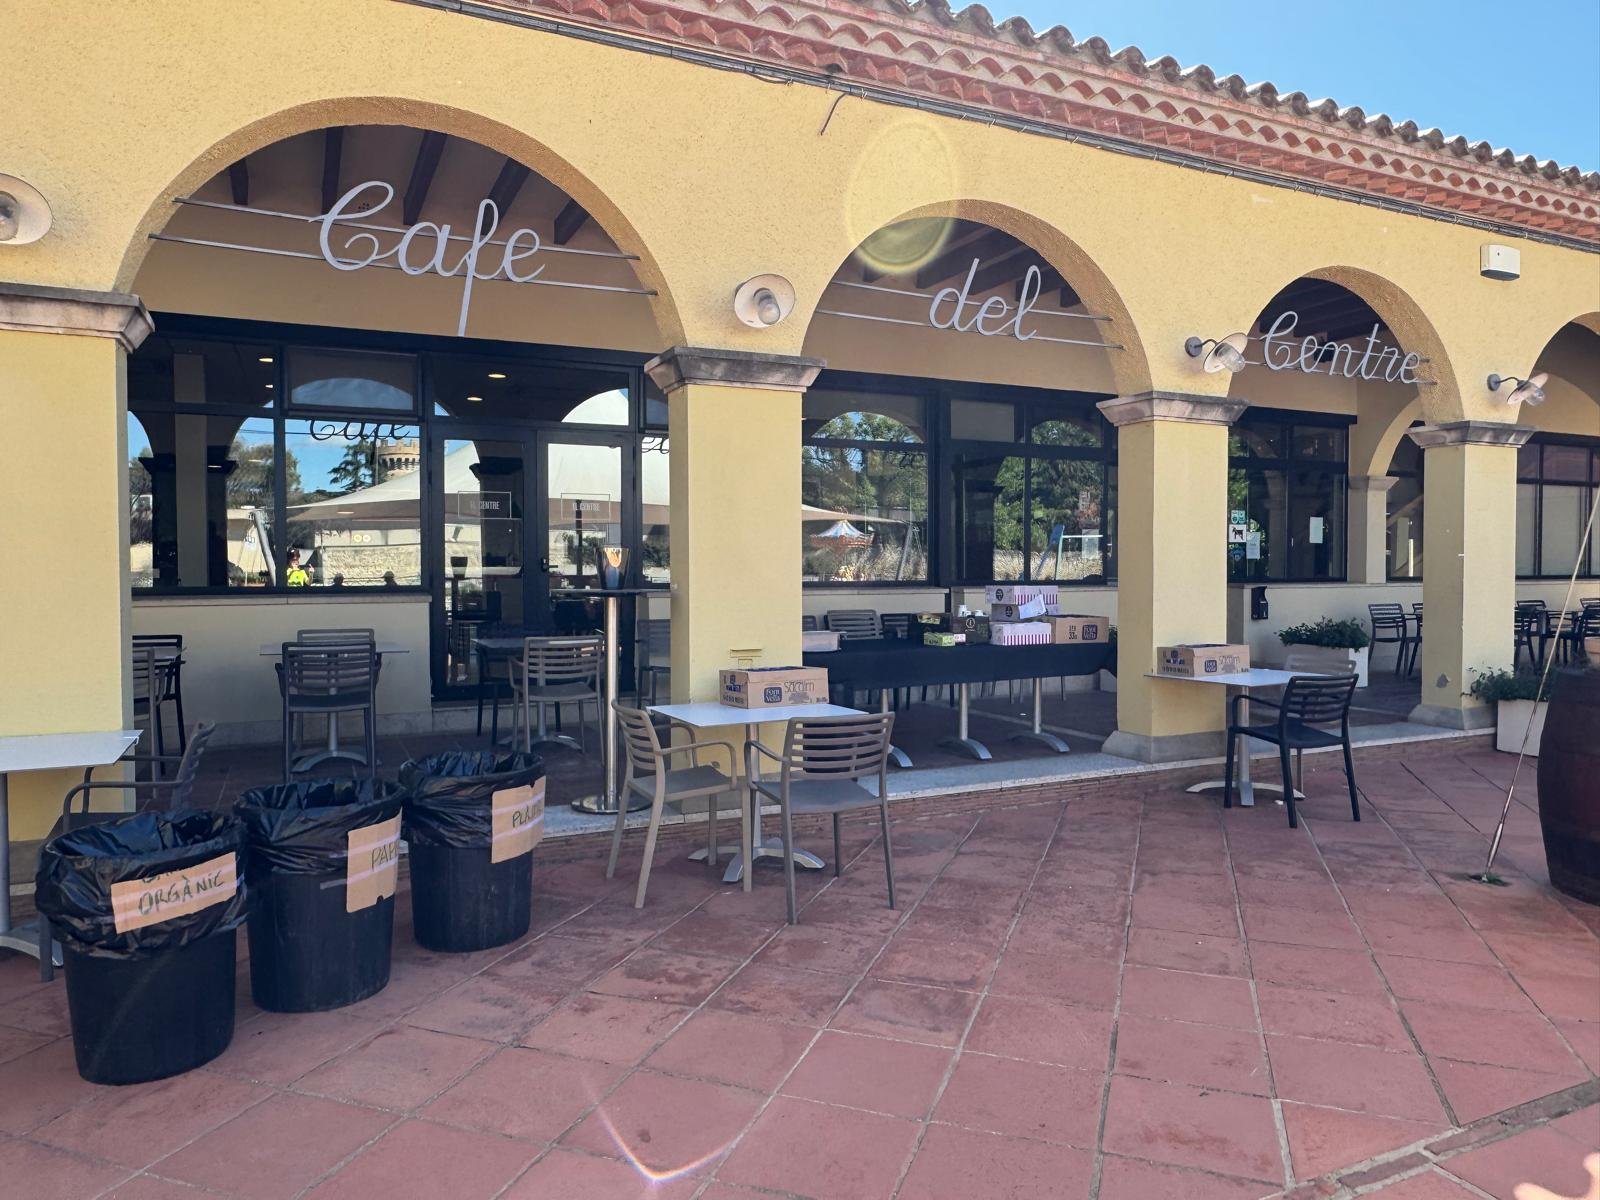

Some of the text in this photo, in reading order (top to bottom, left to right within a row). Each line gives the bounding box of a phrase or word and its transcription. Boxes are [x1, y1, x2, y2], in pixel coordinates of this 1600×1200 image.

[309, 181, 545, 337] Cafe
[929, 257, 1041, 341] del
[1259, 311, 1420, 384] Centre
